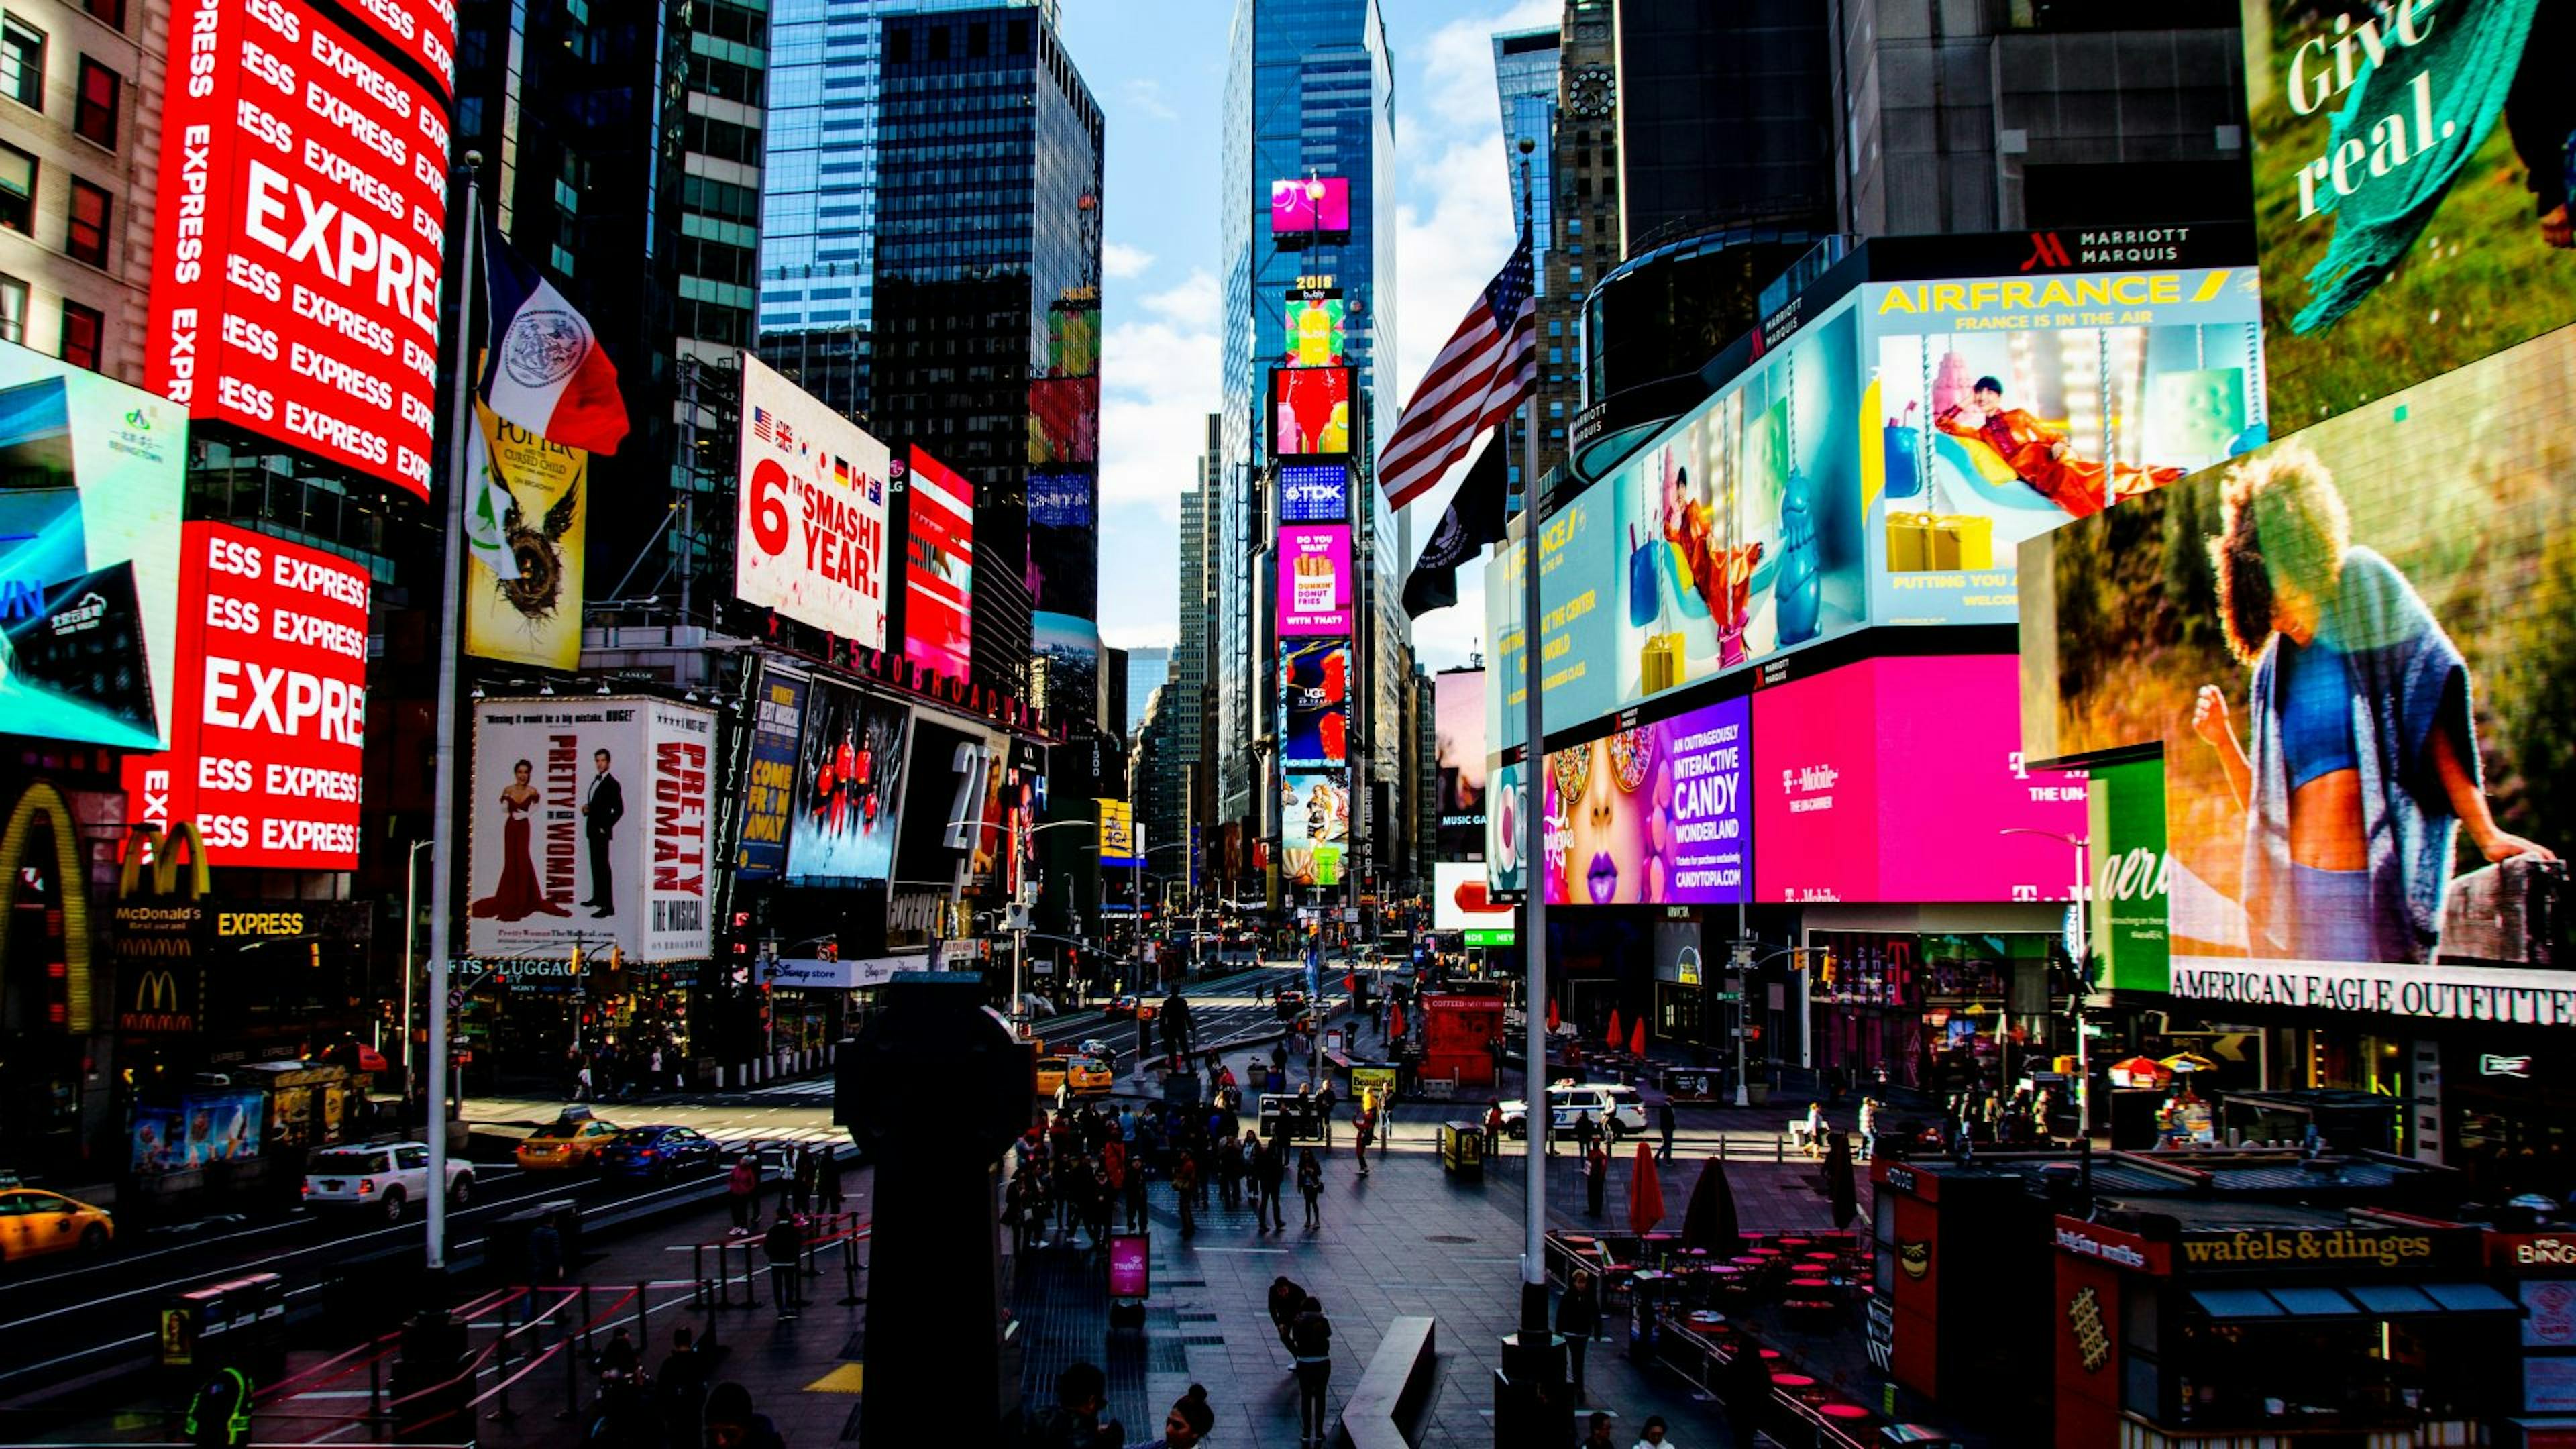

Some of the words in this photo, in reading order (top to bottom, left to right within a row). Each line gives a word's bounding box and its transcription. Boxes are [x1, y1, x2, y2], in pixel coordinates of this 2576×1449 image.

[189, 0, 219, 98] RESS
[2288, 0, 2436, 116] Give
[311, 30, 411, 119] EXPRESS
[306, 80, 407, 166] EXPRESS
[2294, 70, 2455, 222] real.
[304, 138, 405, 220] EXPRESS
[175, 124, 210, 284] EXPRESS
[2082, 229, 2188, 245] MARRIOTT
[2082, 246, 2178, 262] MARQUIS
[1296, 274, 1332, 289] 2018
[1878, 275, 2180, 315] AIRFRANCE
[292, 284, 394, 356] EXPRESS
[1766, 298, 1802, 333] MARRIOTT
[1955, 313, 2029, 329] FRANCE
[2034, 312, 2050, 327] IS
[2055, 312, 2074, 326] IN
[2081, 311, 2114, 325] THE
[2121, 310, 2152, 323] AIR
[1766, 317, 1799, 349] MARQUIS
[291, 341, 392, 410] EXPRESS
[284, 400, 388, 464] EXPRESS
[504, 449, 538, 466] CURSED
[539, 458, 566, 474] CHILD
[1300, 485, 1341, 499] TDK
[802, 483, 871, 550] SMASH
[1296, 536, 1311, 544] DO
[1313, 535, 1333, 543] YOU
[1300, 544, 1328, 552] WANT
[209, 537, 262, 580] ESS
[274, 554, 364, 609] EXPRESS
[1893, 575, 1966, 590] PUTTING
[1970, 574, 2007, 587] YOU
[1287, 616, 1311, 625] WITH
[1313, 616, 1342, 625] THAT?
[1552, 606, 1565, 627] THE
[1567, 590, 1595, 622] CENTER
[206, 594, 260, 635] ESS
[273, 608, 363, 659] EXPRESS
[826, 631, 902, 683] 1540
[1545, 633, 1570, 662] WORLD
[1305, 688, 1326, 698] UGG
[523, 714, 542, 724] would
[545, 714, 553, 724] be
[555, 714, 559, 724] a
[562, 713, 572, 725] big
[1674, 738, 1684, 753] AN
[1685, 724, 1739, 751] OUTRAGEOUSLY
[547, 735, 577, 809] PRETTY
[752, 759, 794, 790] COME
[1674, 746, 1739, 780] INTERACTIVE
[199, 756, 252, 792] ESS
[266, 763, 356, 803] EXPRESS
[2029, 787, 2059, 802] THE
[747, 785, 790, 816] FROM
[1675, 772, 1739, 820] CANDY
[653, 742, 681, 892] WOMAN
[678, 743, 706, 897] PRETTY
[743, 811, 788, 843] AWAY
[1442, 816, 1471, 826] MUSIC
[1473, 815, 1487, 825] GA
[1676, 818, 1739, 843] WONDERLAND
[262, 818, 354, 854] EXPRESS
[546, 822, 576, 905] WOMAN
[1676, 869, 1741, 887] CANDYTOPIA.COM
[115, 906, 202, 921] McDonald's
[218, 913, 303, 936] EXPRESS
[653, 900, 667, 932] THE
[669, 900, 703, 932] MUSICAL
[665, 940, 703, 951] BROADWAY
[426, 959, 483, 975] GFTS
[812, 969, 835, 979] store
[2173, 969, 2297, 1006] AMERICAN
[2308, 975, 2393, 1012] EAGLE
[1353, 1075, 1394, 1088] Beautiful
